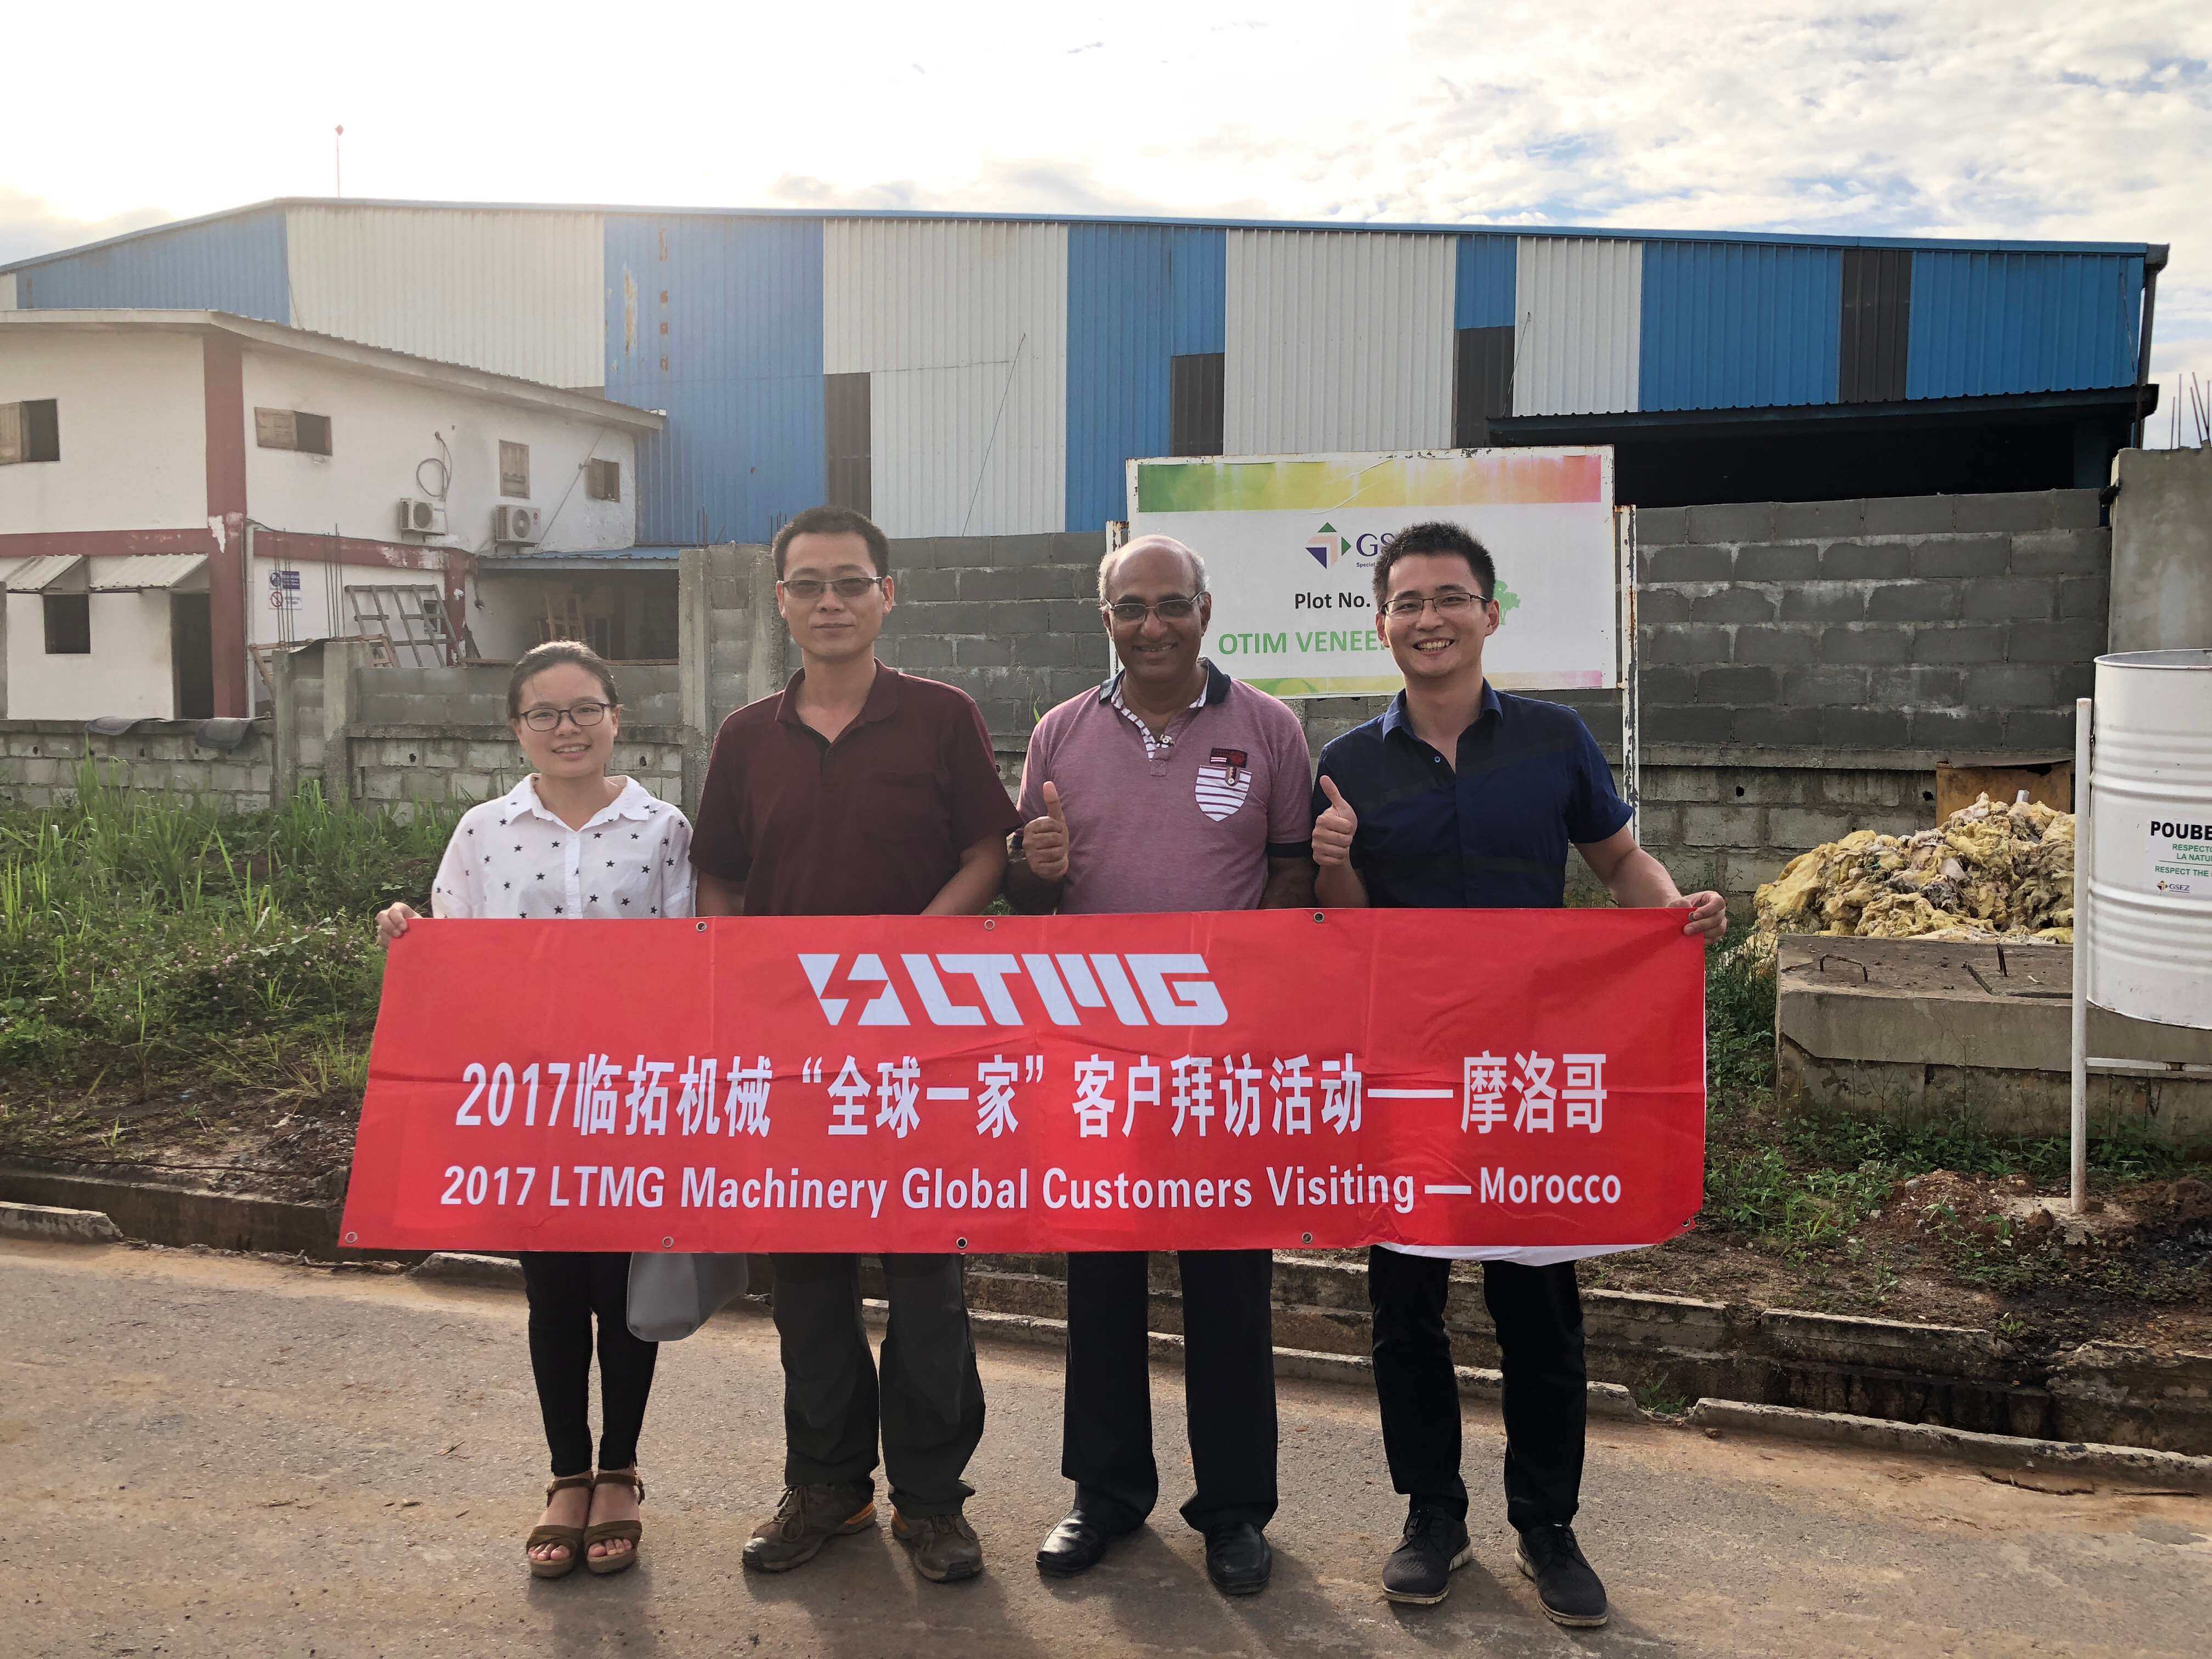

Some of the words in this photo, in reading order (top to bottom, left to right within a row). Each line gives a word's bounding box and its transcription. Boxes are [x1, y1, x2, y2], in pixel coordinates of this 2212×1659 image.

[1295, 592, 1332, 609] Plot
[1339, 592, 1370, 608] No.
[1218, 632, 1286, 654] OTIM
[1295, 630, 1385, 652] VENEE
[2155, 866, 2191, 876] RESPECT
[2169, 883, 2190, 891] GSEZ
[901, 954, 1228, 1025] LTMG
[441, 1166, 535, 1205] 2017
[550, 1166, 664, 1207] LTMG
[681, 1167, 888, 1218] Machinery
[902, 1167, 1028, 1209] Global
[1043, 1168, 1251, 1209] Customers
[1266, 1164, 1414, 1214] Visiting
